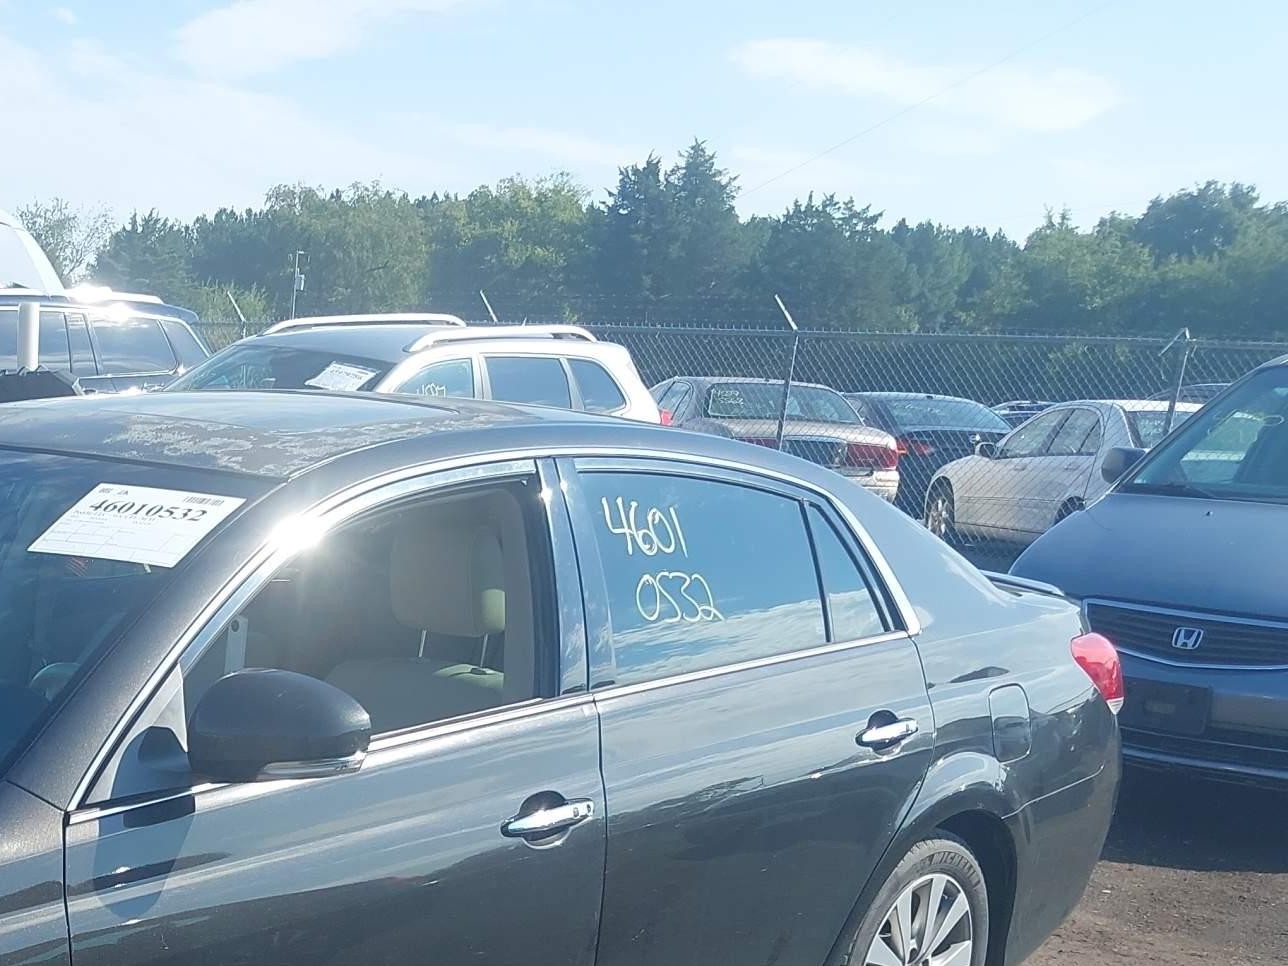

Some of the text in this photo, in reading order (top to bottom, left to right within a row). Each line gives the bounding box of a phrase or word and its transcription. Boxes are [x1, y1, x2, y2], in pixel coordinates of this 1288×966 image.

[89, 499, 208, 522] 46010532
[601, 496, 688, 558] 4601
[636, 571, 725, 622] 0532
